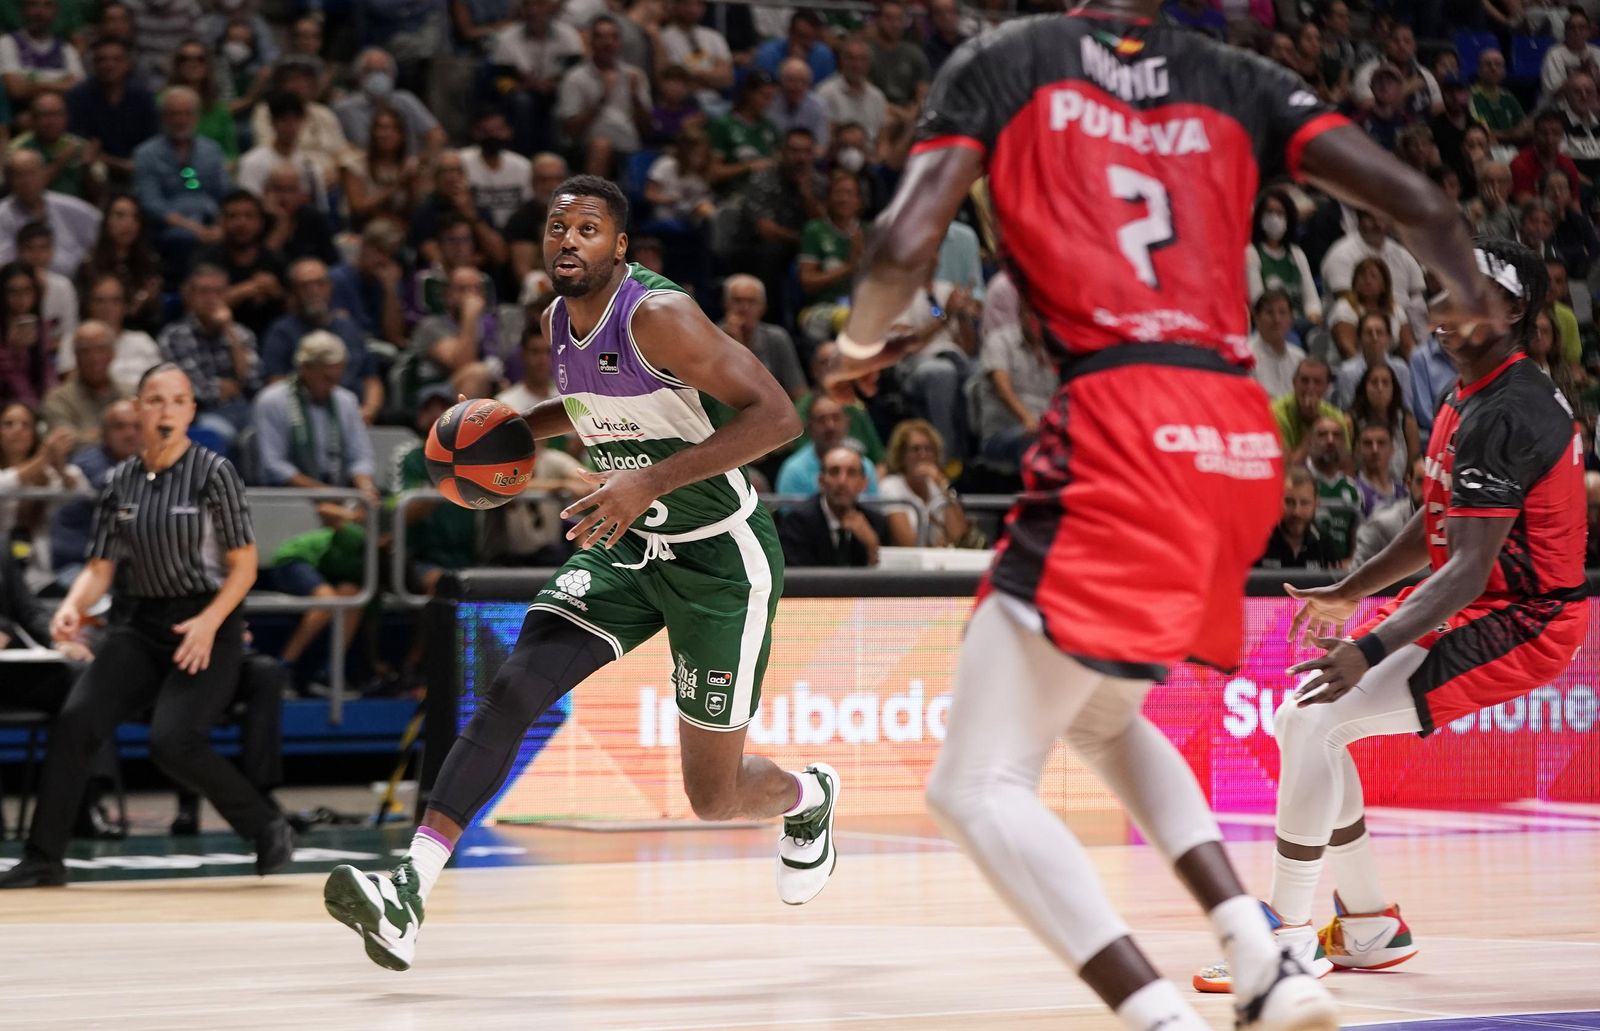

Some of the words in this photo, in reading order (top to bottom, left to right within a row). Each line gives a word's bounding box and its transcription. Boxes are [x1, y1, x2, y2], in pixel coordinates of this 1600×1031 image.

[1051, 89, 1212, 155] PULEVA
[1107, 163, 1174, 281] 7
[493, 472, 517, 488] liga
[710, 676, 727, 684] acb
